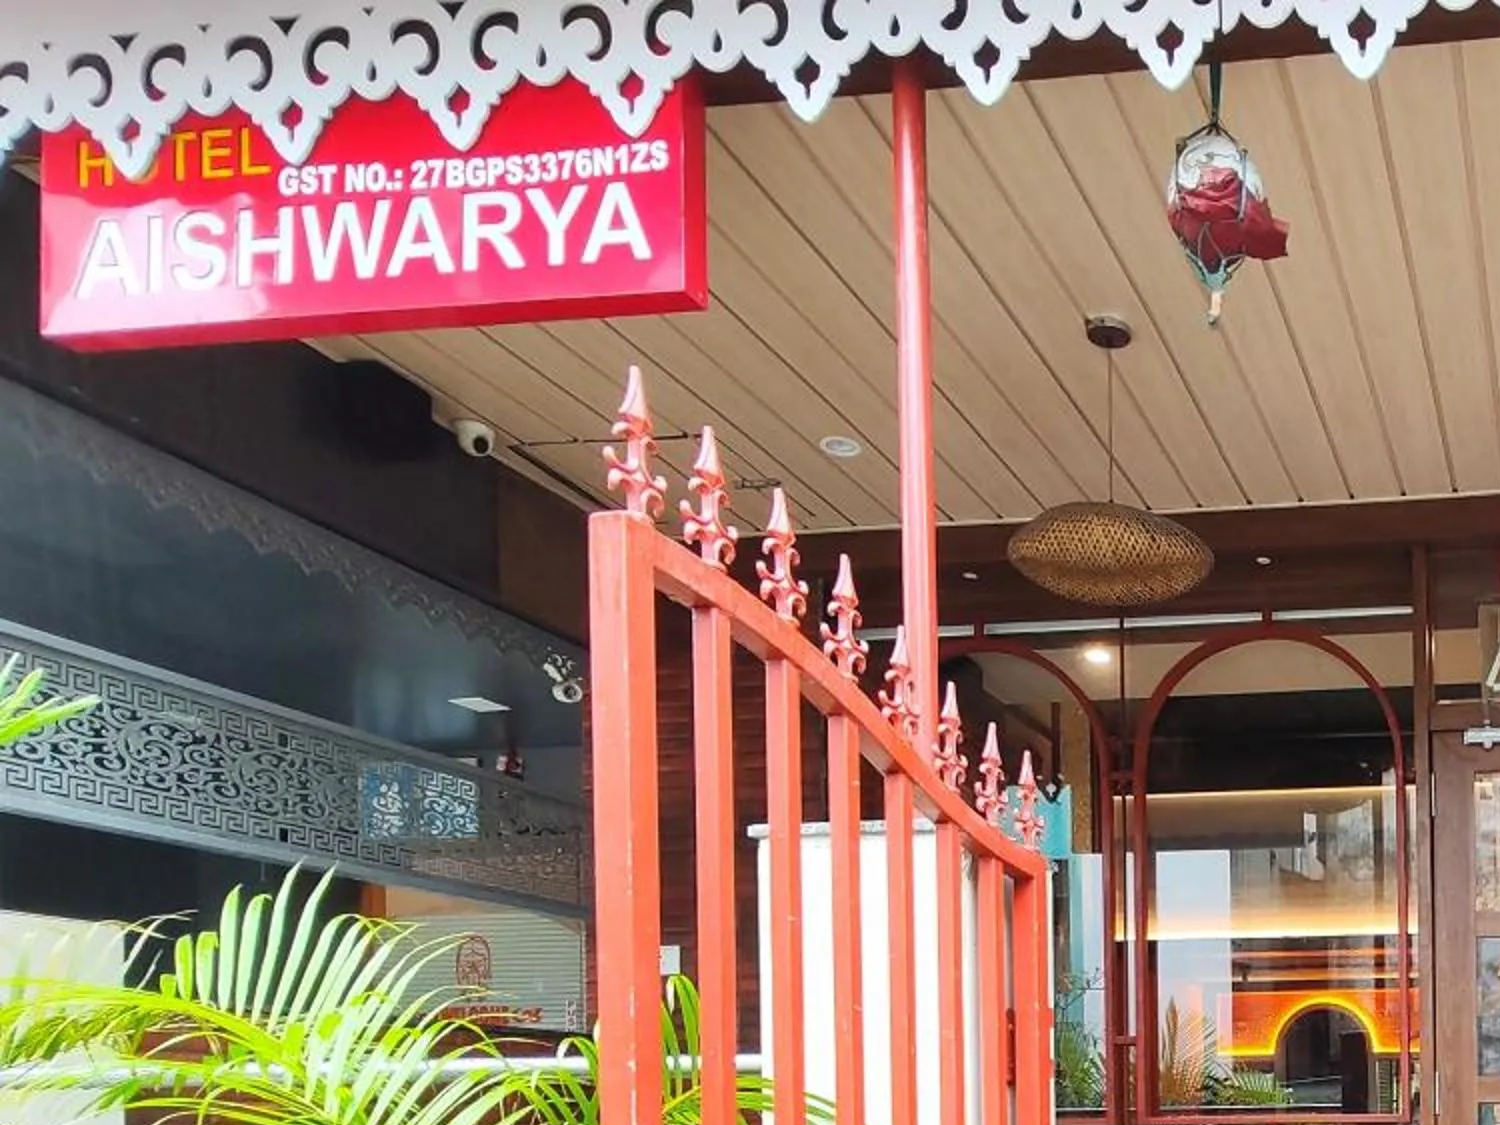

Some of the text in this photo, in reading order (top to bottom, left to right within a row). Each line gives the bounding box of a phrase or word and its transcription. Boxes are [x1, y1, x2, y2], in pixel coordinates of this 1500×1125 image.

[78, 127, 273, 188] HTEL
[277, 164, 338, 197] GST
[343, 162, 404, 194] NO.:
[74, 181, 653, 300] AISHWARYA
